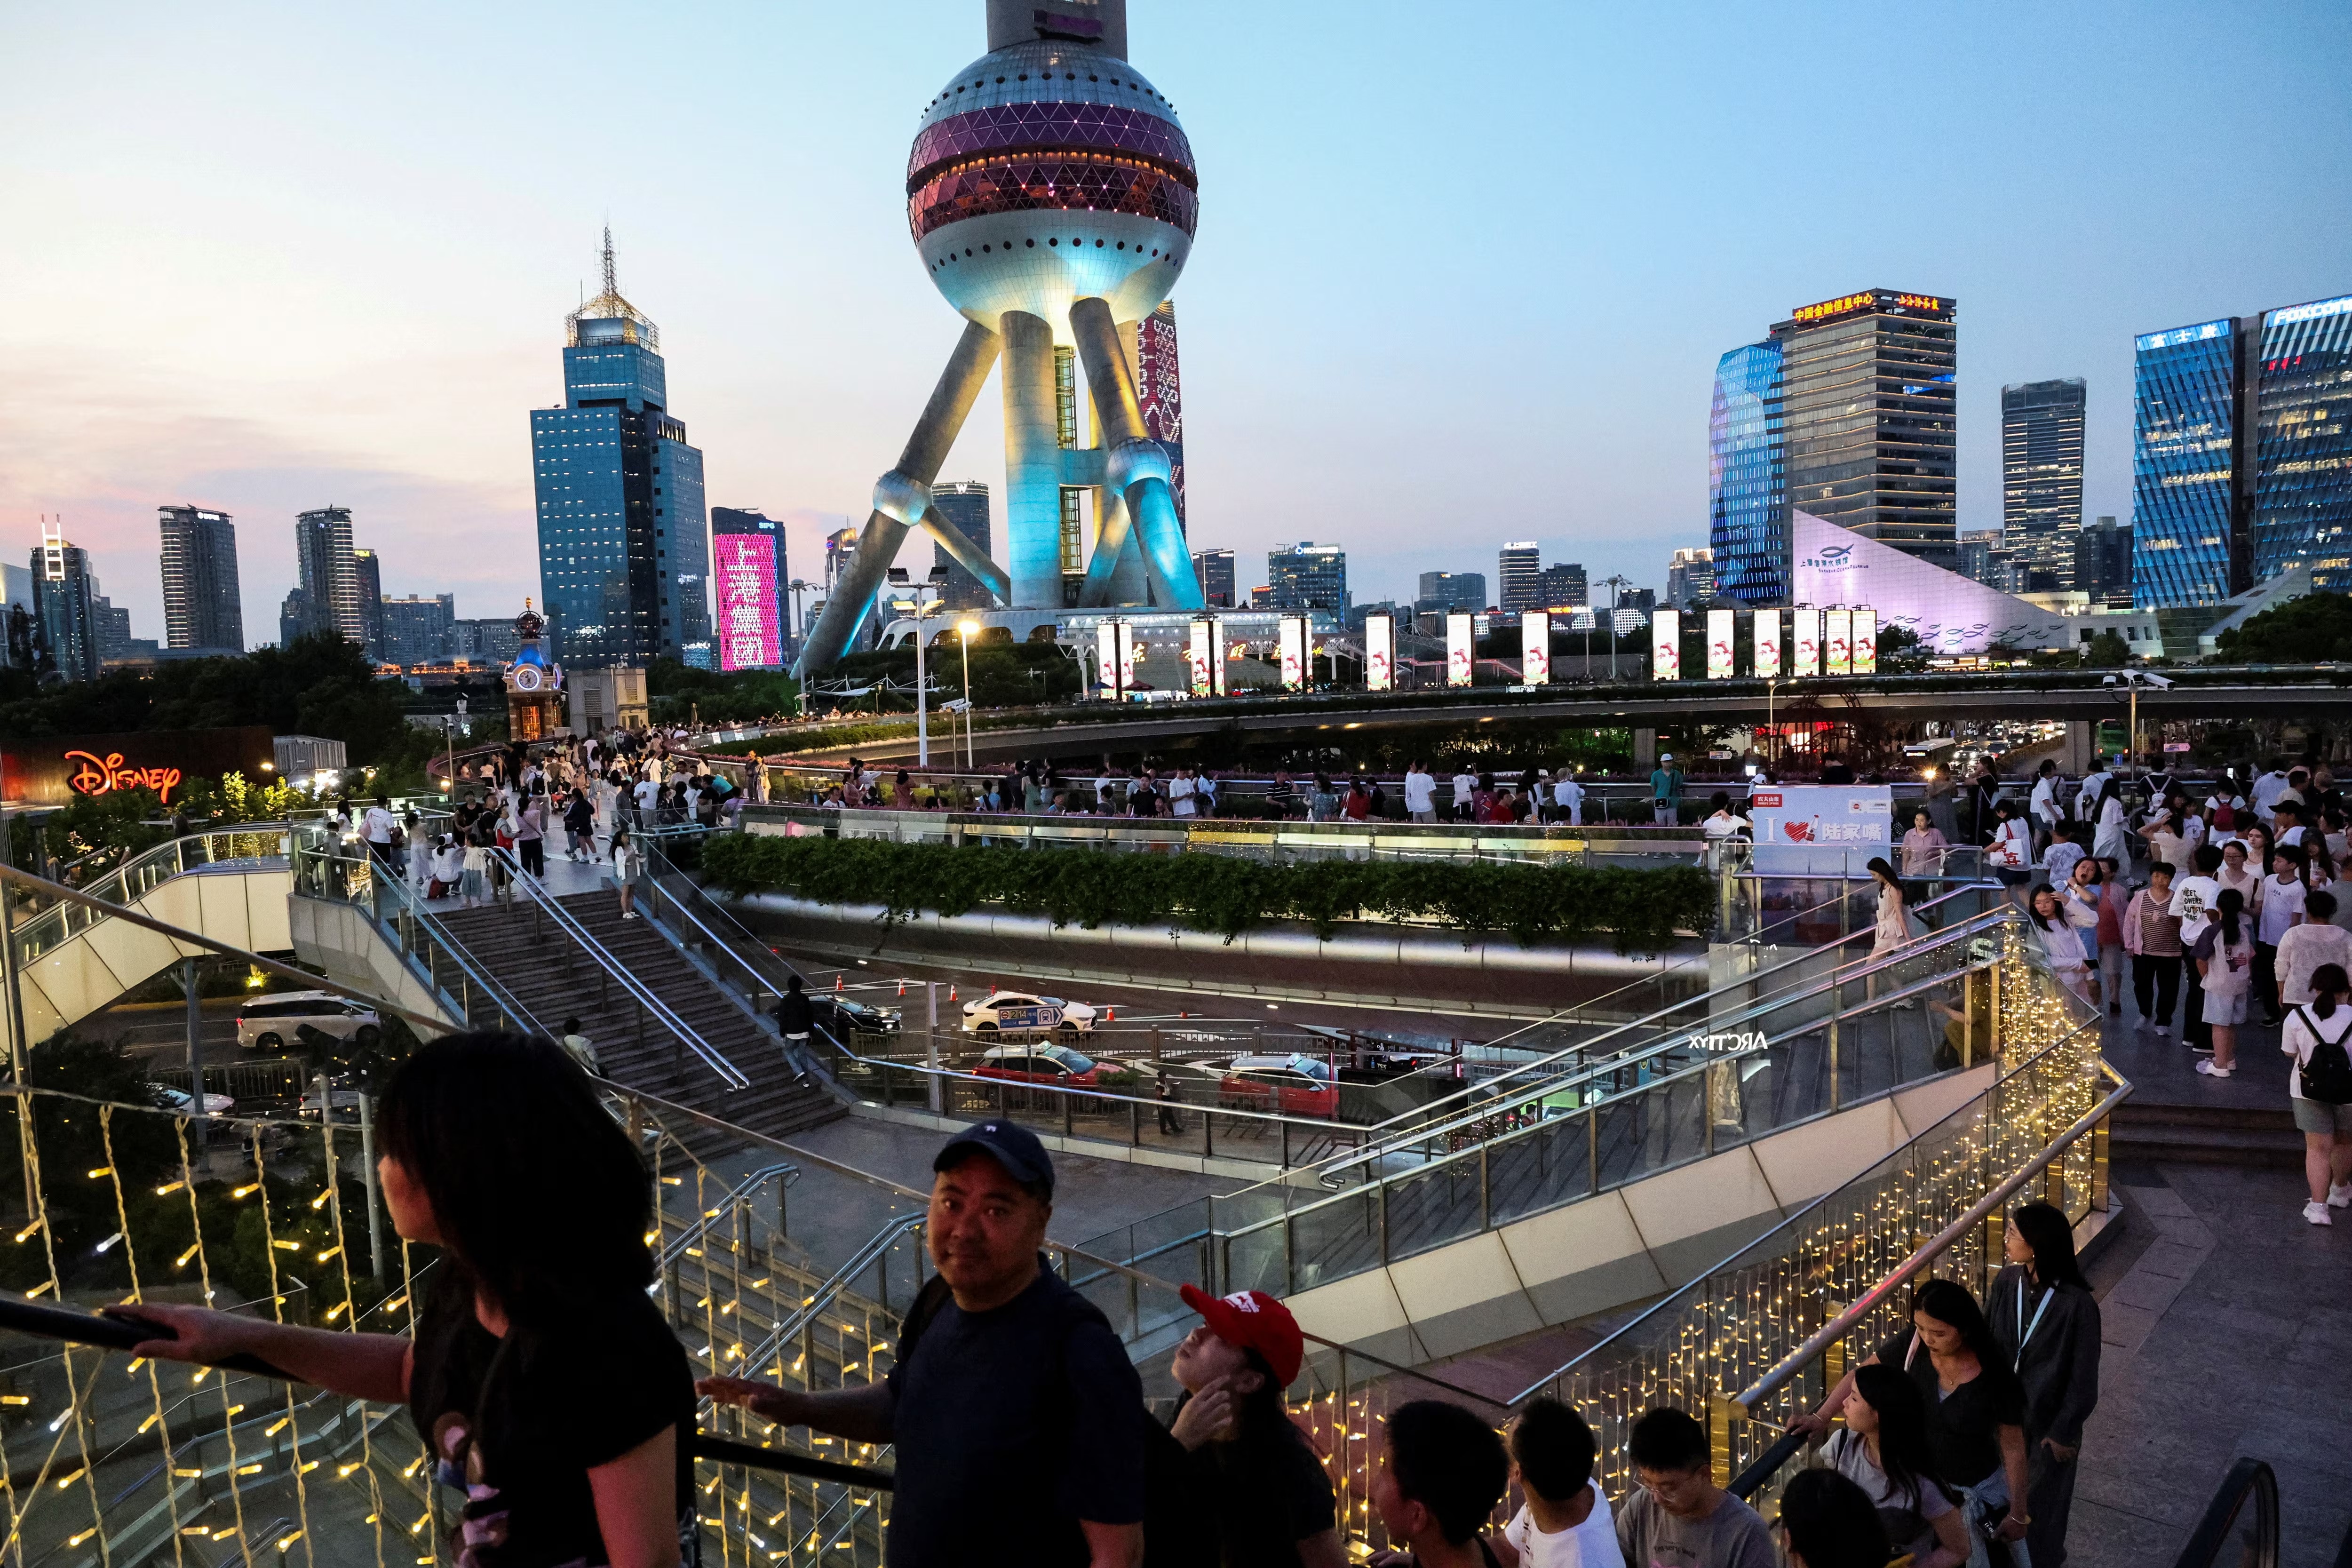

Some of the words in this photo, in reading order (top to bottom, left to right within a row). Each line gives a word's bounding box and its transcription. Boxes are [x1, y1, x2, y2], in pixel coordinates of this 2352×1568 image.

[1795, 292, 1873, 322] 中国金融信息中心
[2151, 324, 2217, 348] 富士康
[955, 484, 967, 493] W
[1765, 817, 1777, 842] I
[1822, 822, 1883, 841] 陆家嘴
